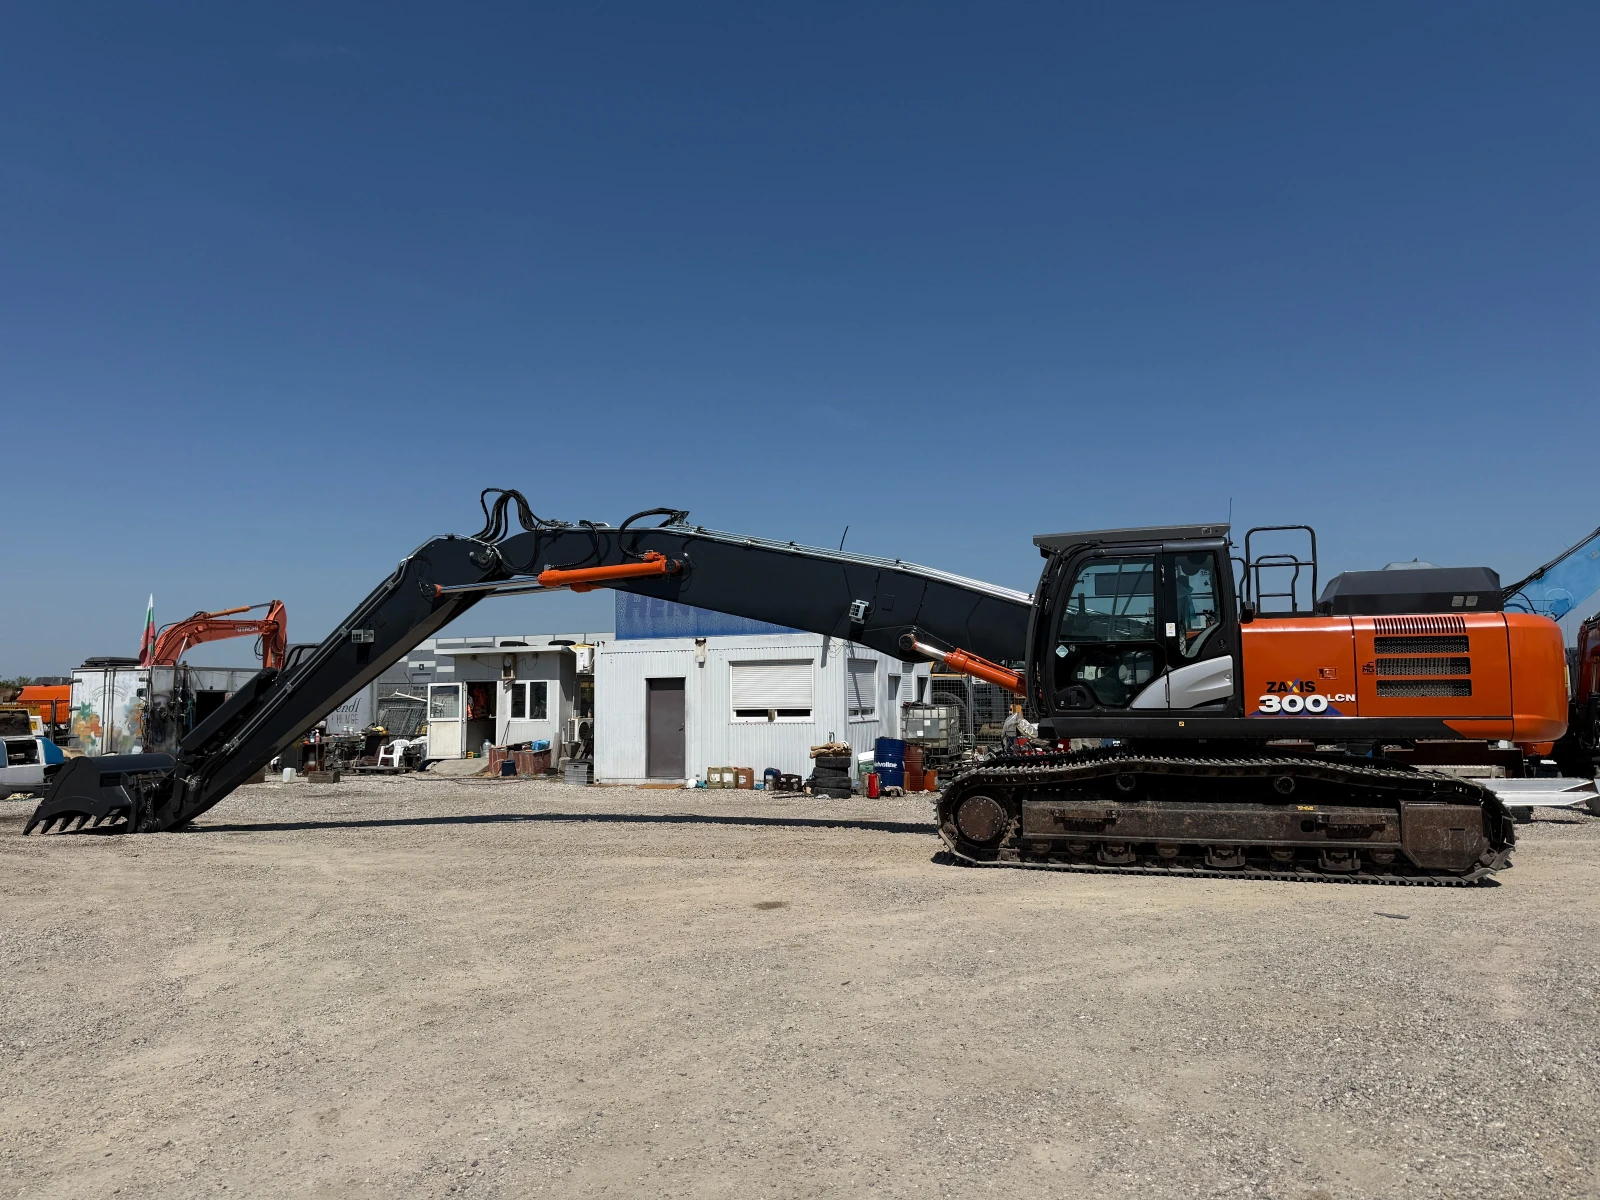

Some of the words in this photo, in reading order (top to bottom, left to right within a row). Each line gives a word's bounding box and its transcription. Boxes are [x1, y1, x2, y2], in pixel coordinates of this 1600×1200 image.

[235, 624, 259, 633] HITACHI
[1266, 678, 1316, 693] ZAXIS
[1258, 694, 1328, 714] 300
[1327, 693, 1356, 702] LCN
